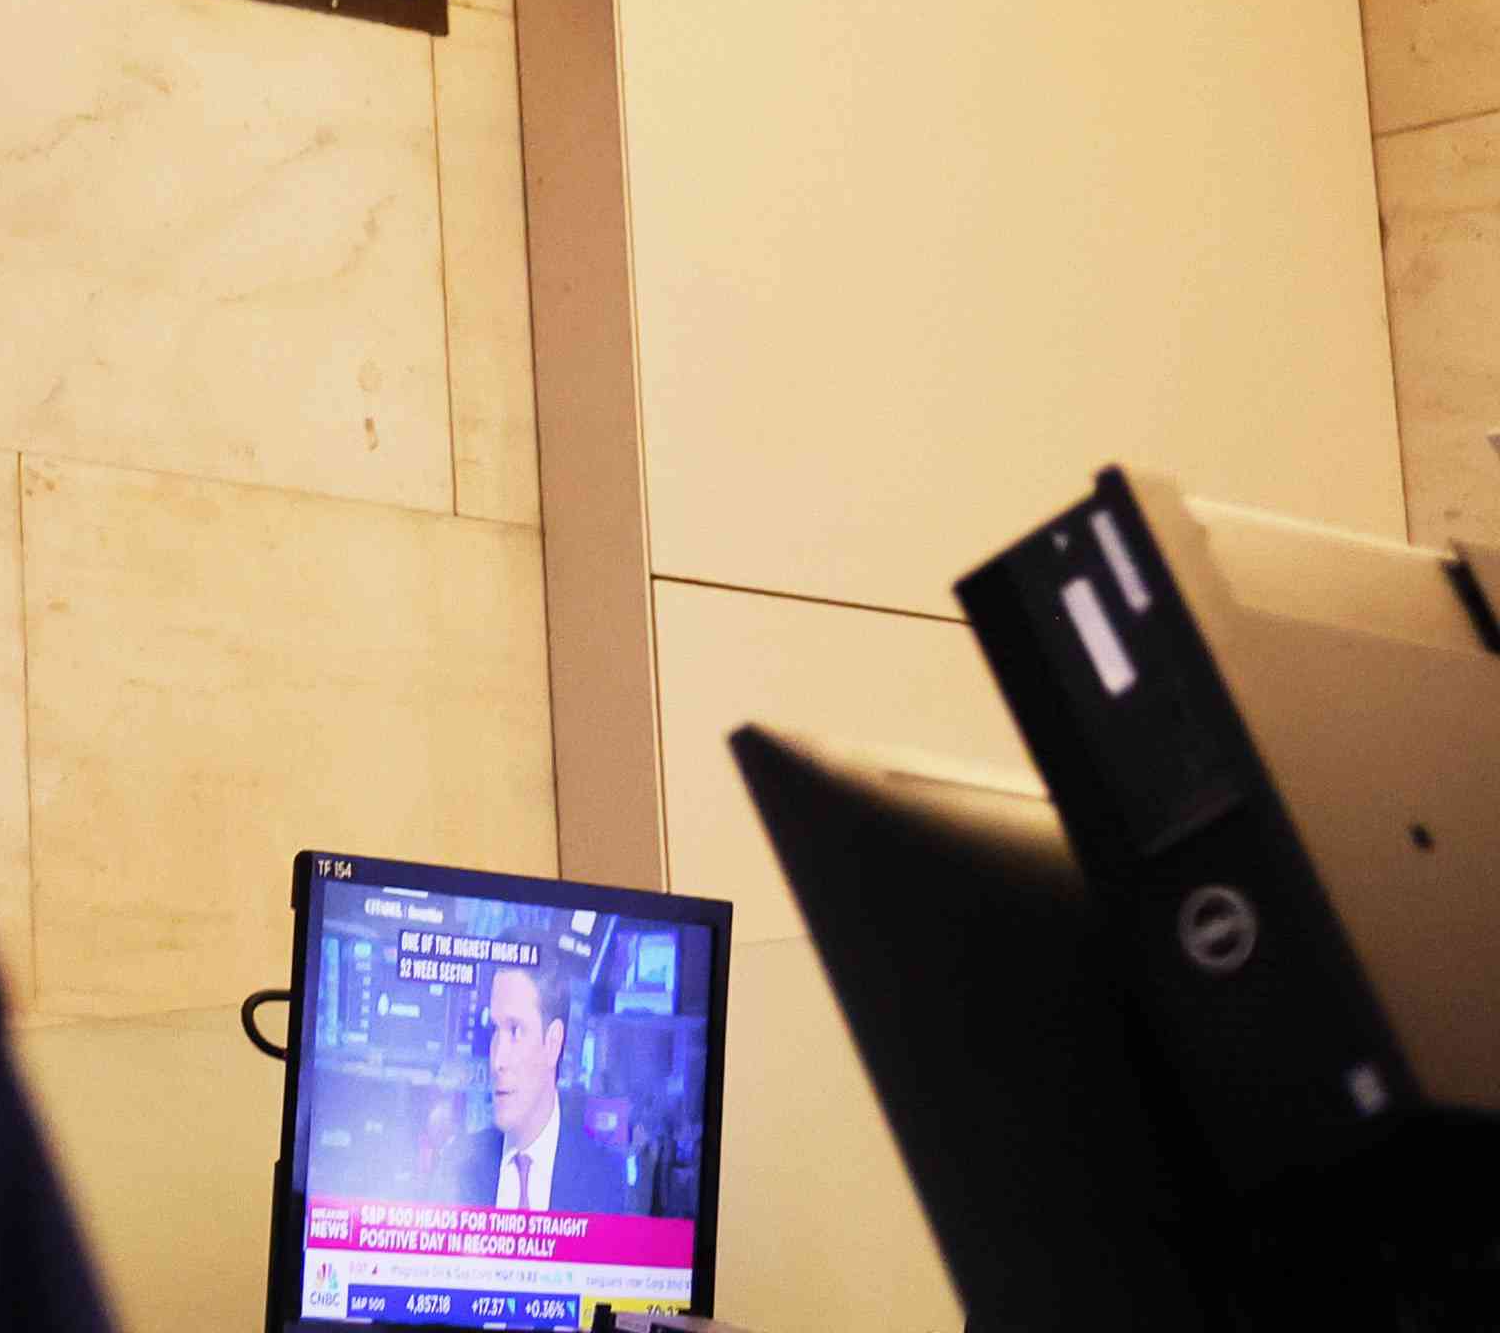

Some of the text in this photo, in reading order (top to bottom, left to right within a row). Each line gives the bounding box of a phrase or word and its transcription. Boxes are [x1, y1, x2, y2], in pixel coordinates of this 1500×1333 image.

[401, 931, 420, 952] ONE
[435, 935, 452, 956] THE
[413, 960, 438, 981] WEEK
[310, 1220, 349, 1240] NEWS
[414, 1209, 457, 1230] HEADS
[460, 1212, 487, 1232] FOR
[489, 1213, 526, 1235] THIRD
[528, 1215, 588, 1238] STRAIGHT
[359, 1229, 556, 1259] POSITIVE DAY IN RECORD RALLY
[309, 1292, 340, 1307] CNBC
